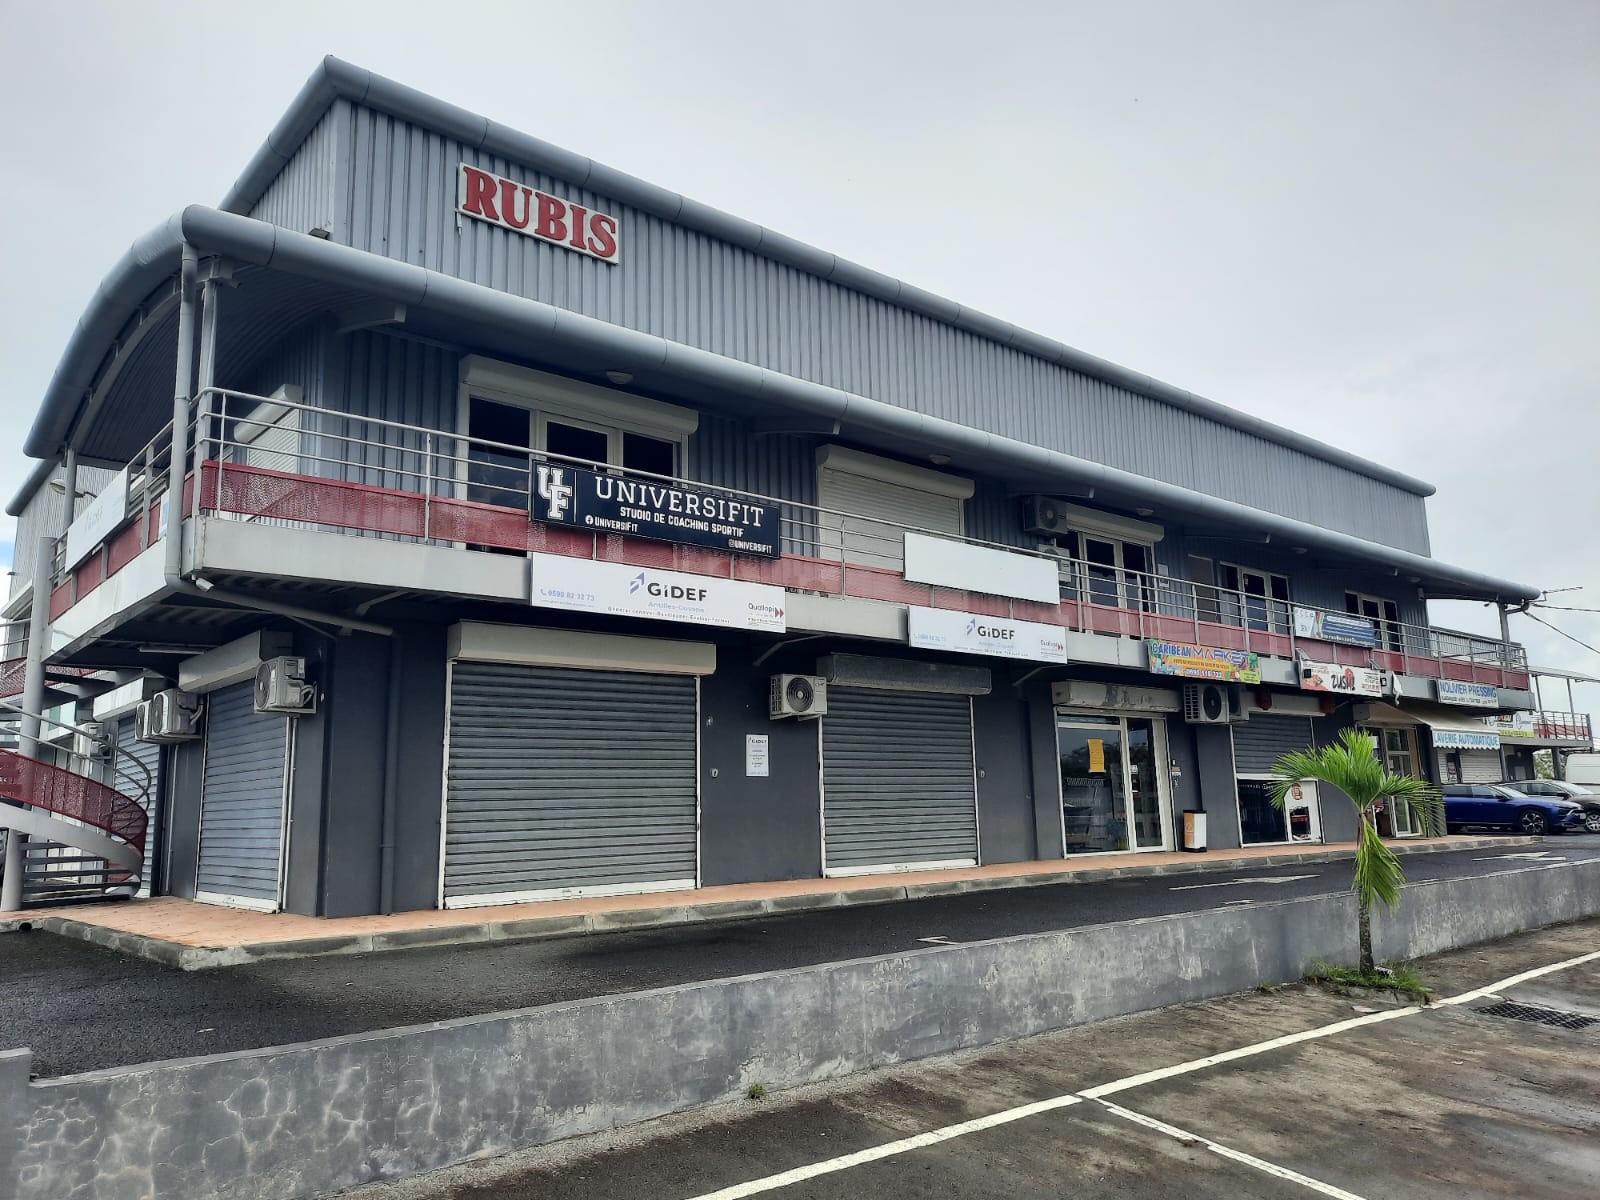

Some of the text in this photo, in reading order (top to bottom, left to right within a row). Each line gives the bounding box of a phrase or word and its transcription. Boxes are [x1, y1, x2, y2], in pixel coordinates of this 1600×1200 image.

[463, 166, 617, 258] RUBIS
[595, 476, 763, 527] UNIVERSIFIT
[595, 516, 638, 532] UNIVERSIFIT
[620, 506, 744, 537] STUDIO DE COACHING SPORTIF
[728, 539, 772, 554] @UNIVERSIFIT
[1152, 643, 1191, 657] CARIBEAN
[1192, 645, 1250, 665] MARKET
[1468, 685, 1497, 698] PRESSING
[1458, 734, 1499, 747] AUTOMATIQUE
